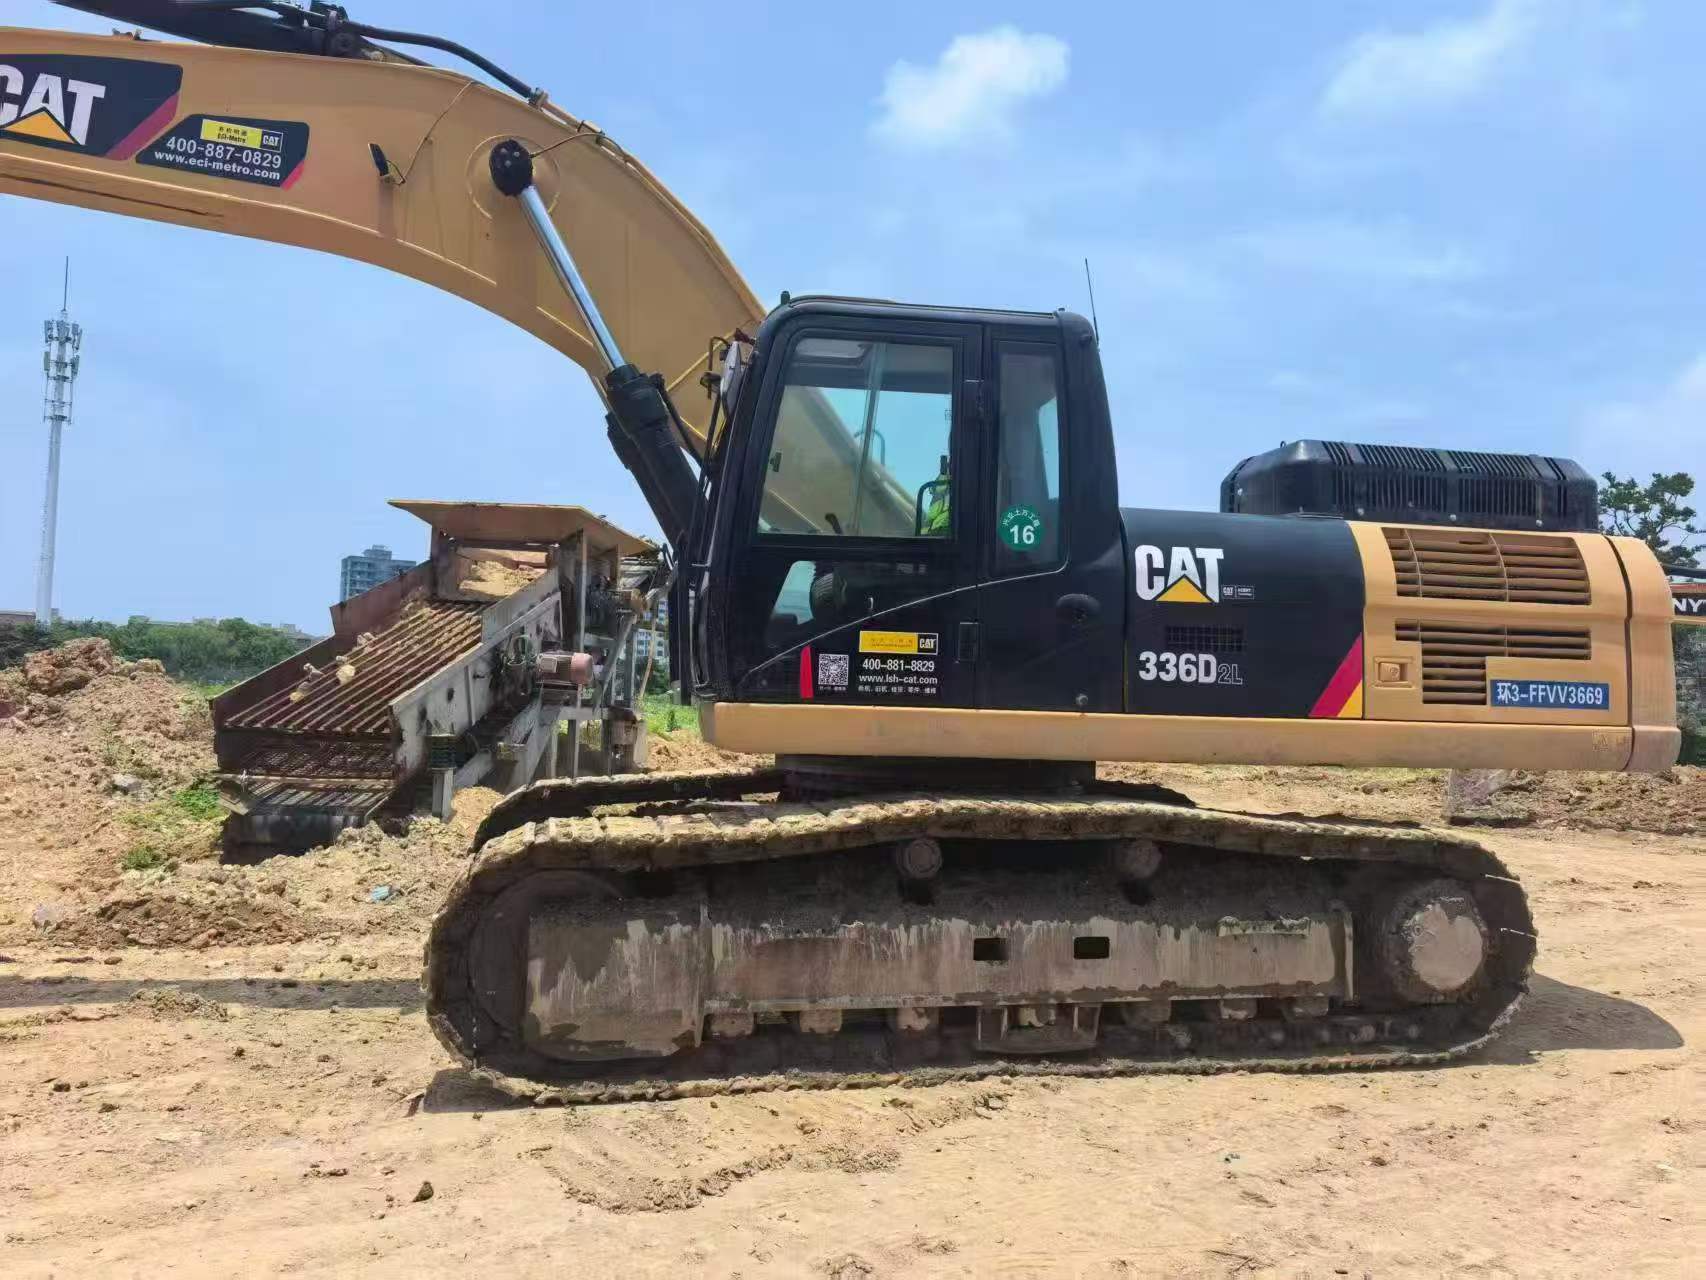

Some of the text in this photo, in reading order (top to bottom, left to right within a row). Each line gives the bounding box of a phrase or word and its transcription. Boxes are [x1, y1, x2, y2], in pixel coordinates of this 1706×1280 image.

[0, 64, 106, 146] CAT
[262, 135, 280, 147] CAT
[166, 136, 282, 169] 400-887-0829
[154, 150, 281, 180] www.eci-metro.com
[1010, 524, 1035, 544] 16
[1134, 545, 1224, 604] CAT
[1672, 598, 1706, 613] NY
[919, 638, 936, 649] CAT
[862, 658, 935, 672] 400-881-8829
[1138, 651, 1242, 684] 336D2L
[859, 674, 938, 685] www.lsh-cat.com
[1496, 682, 1603, 705] 环3-FFVV3669
